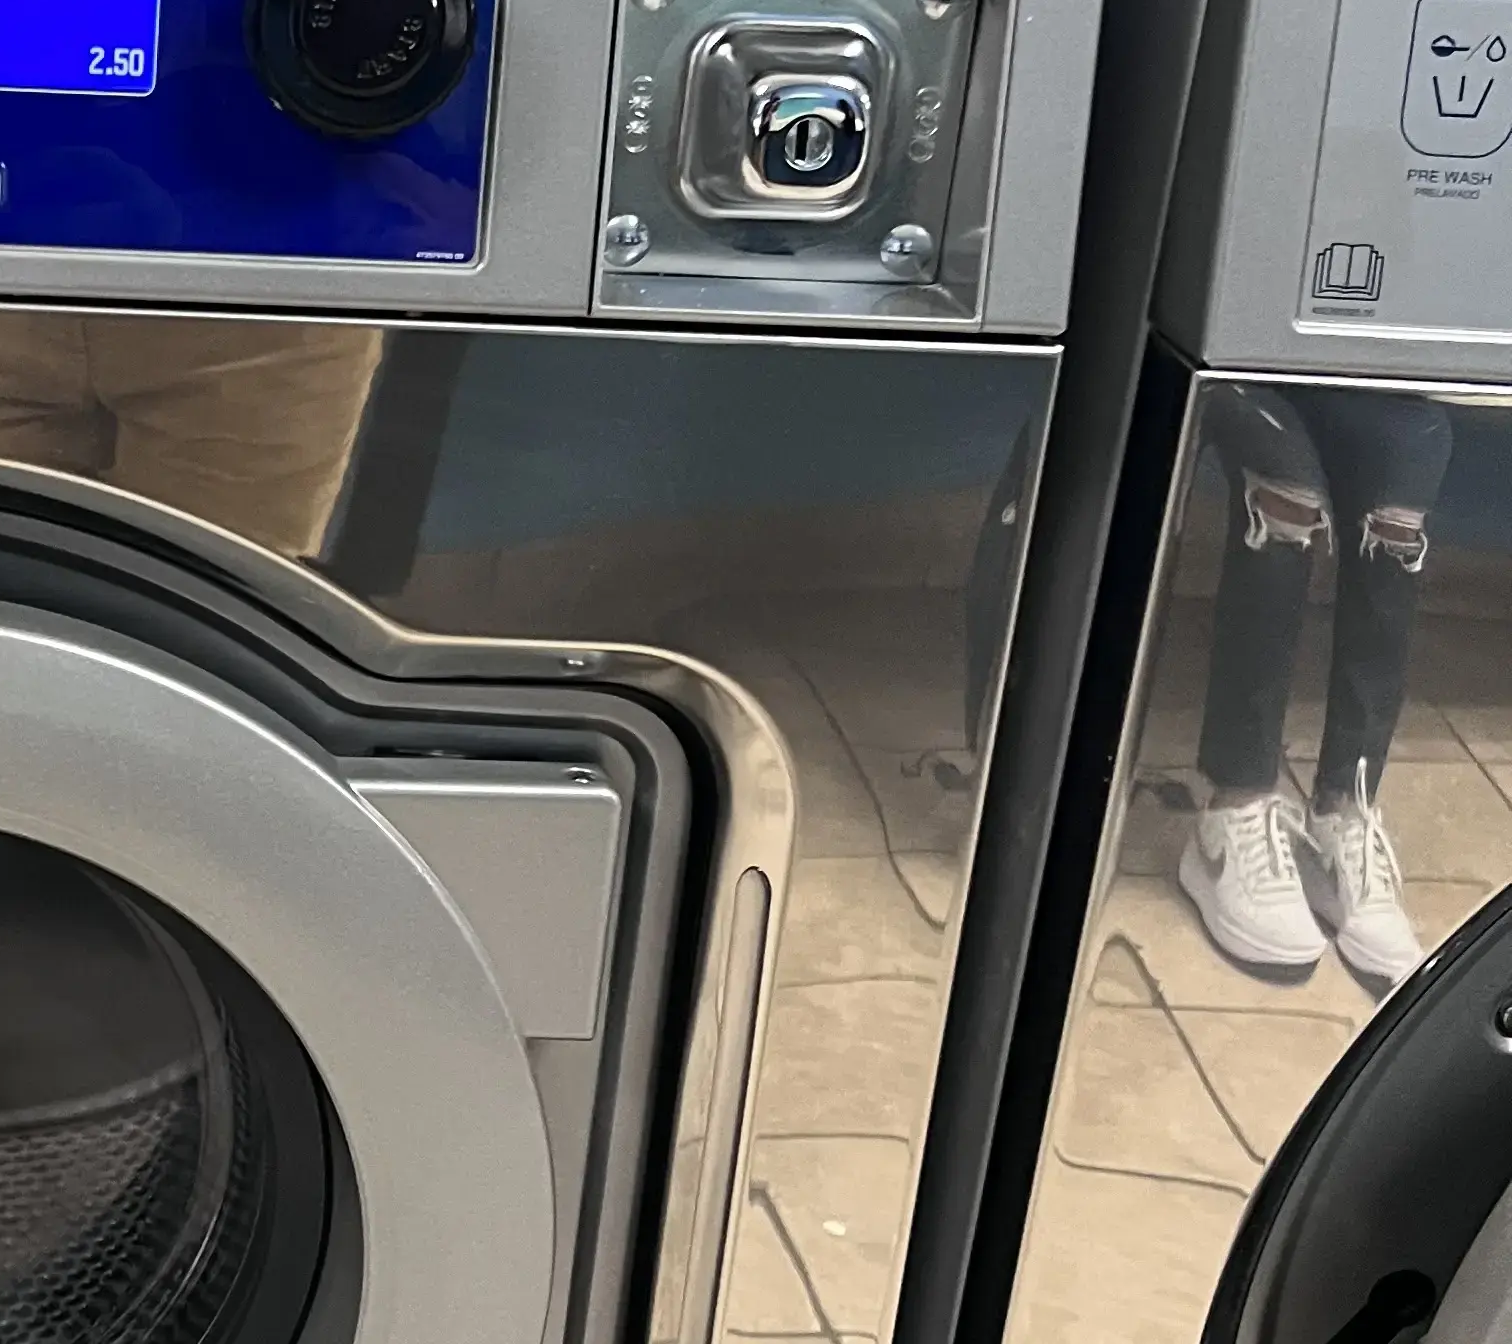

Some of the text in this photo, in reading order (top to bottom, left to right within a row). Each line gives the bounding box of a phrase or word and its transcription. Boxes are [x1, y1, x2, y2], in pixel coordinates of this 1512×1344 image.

[89, 47, 145, 77] 2.50
[1407, 169, 1492, 185] PRE WASH
